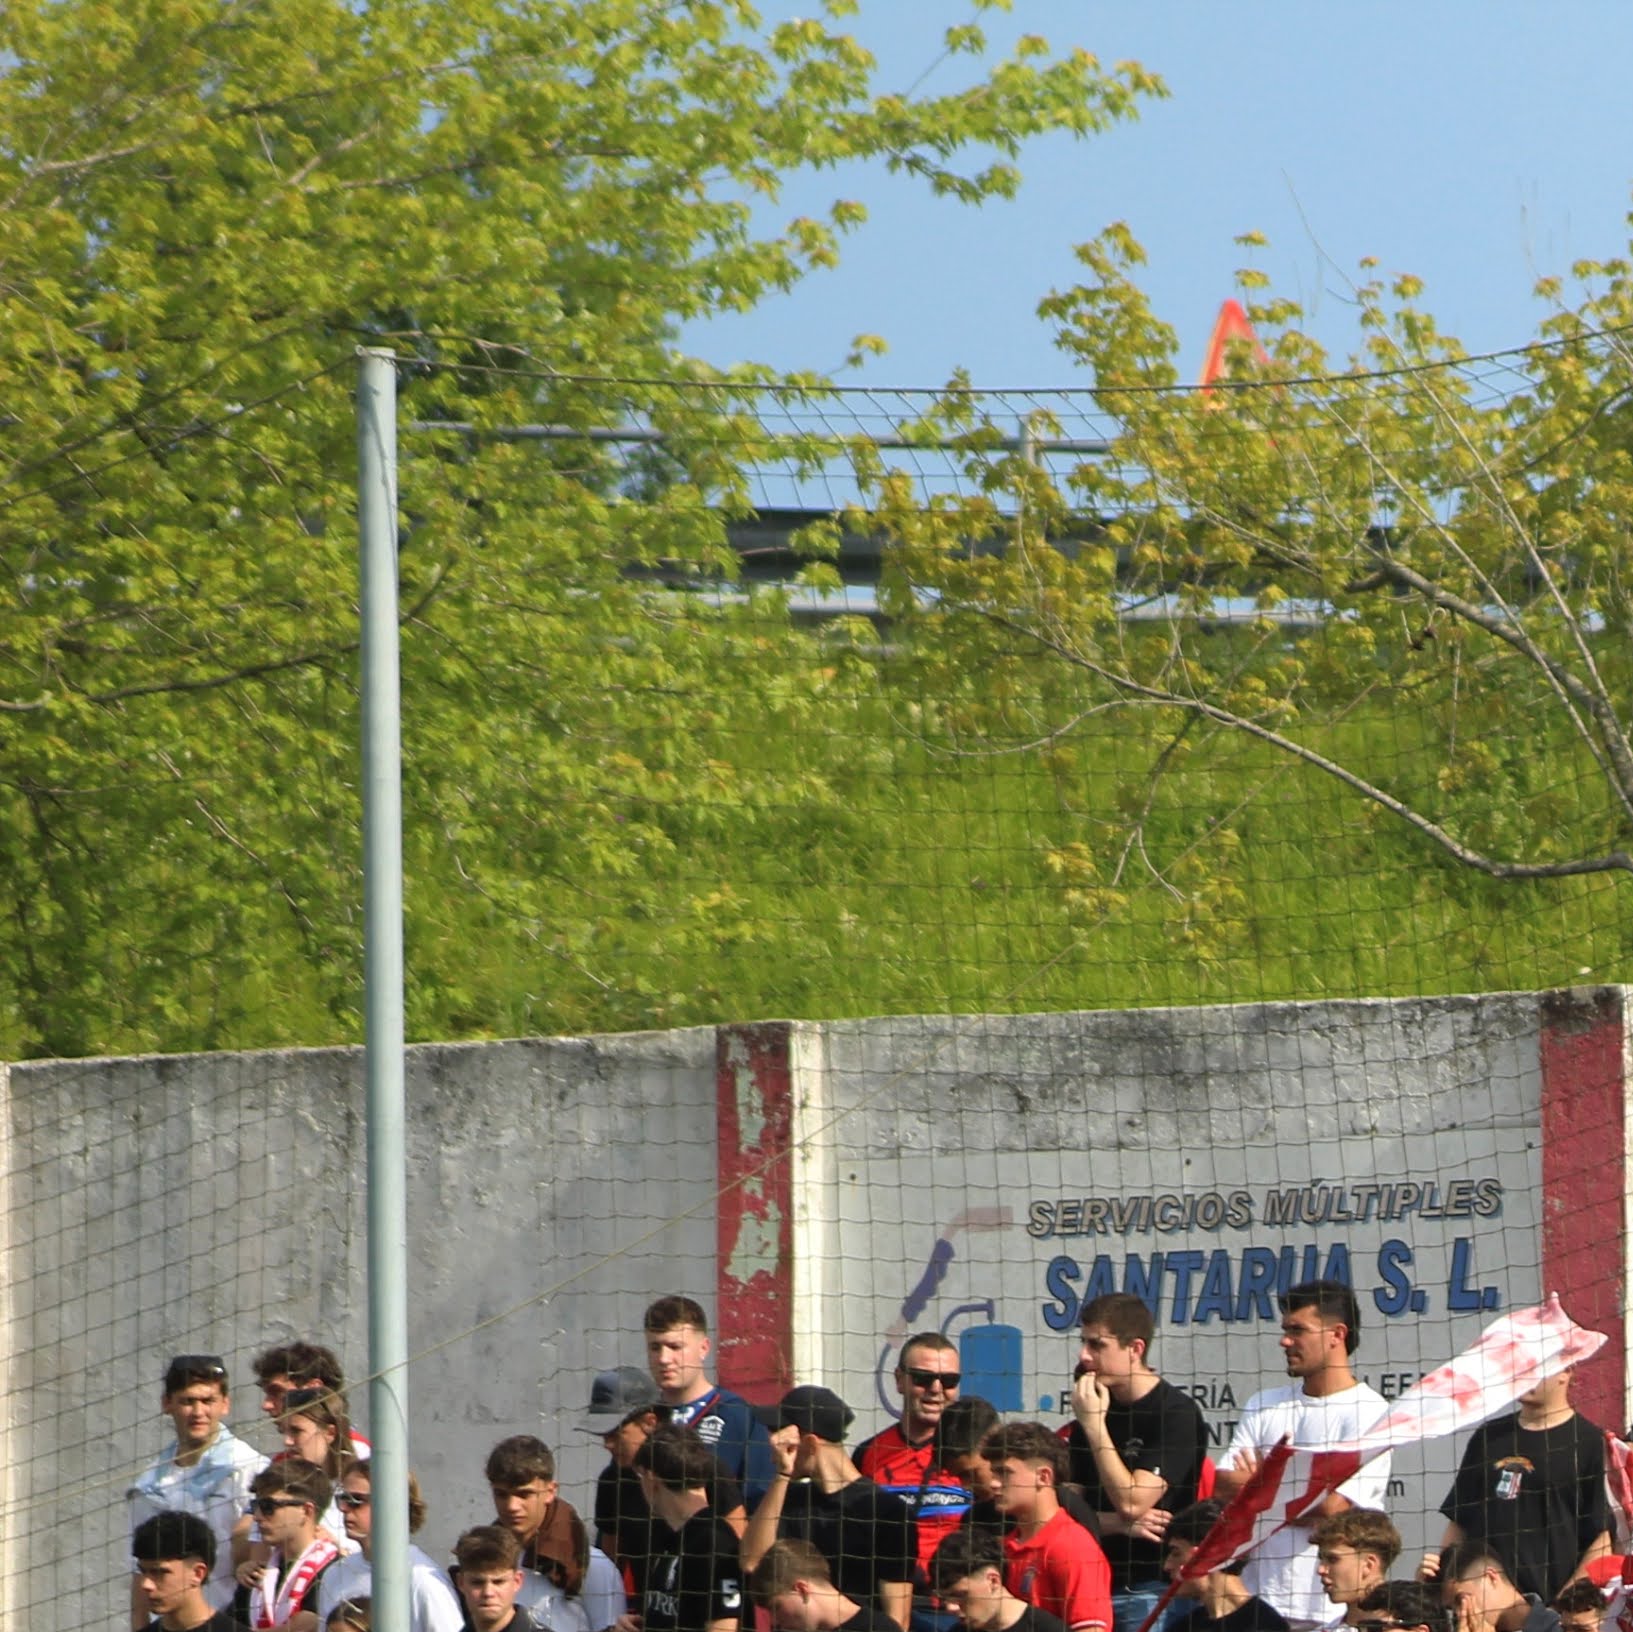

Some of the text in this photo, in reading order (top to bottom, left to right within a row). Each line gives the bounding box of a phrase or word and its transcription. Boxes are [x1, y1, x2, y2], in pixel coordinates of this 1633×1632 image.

[1026, 1178, 1504, 1238] SERVICIOS MÚLTIPLES
[720, 1578, 742, 1608] 5
